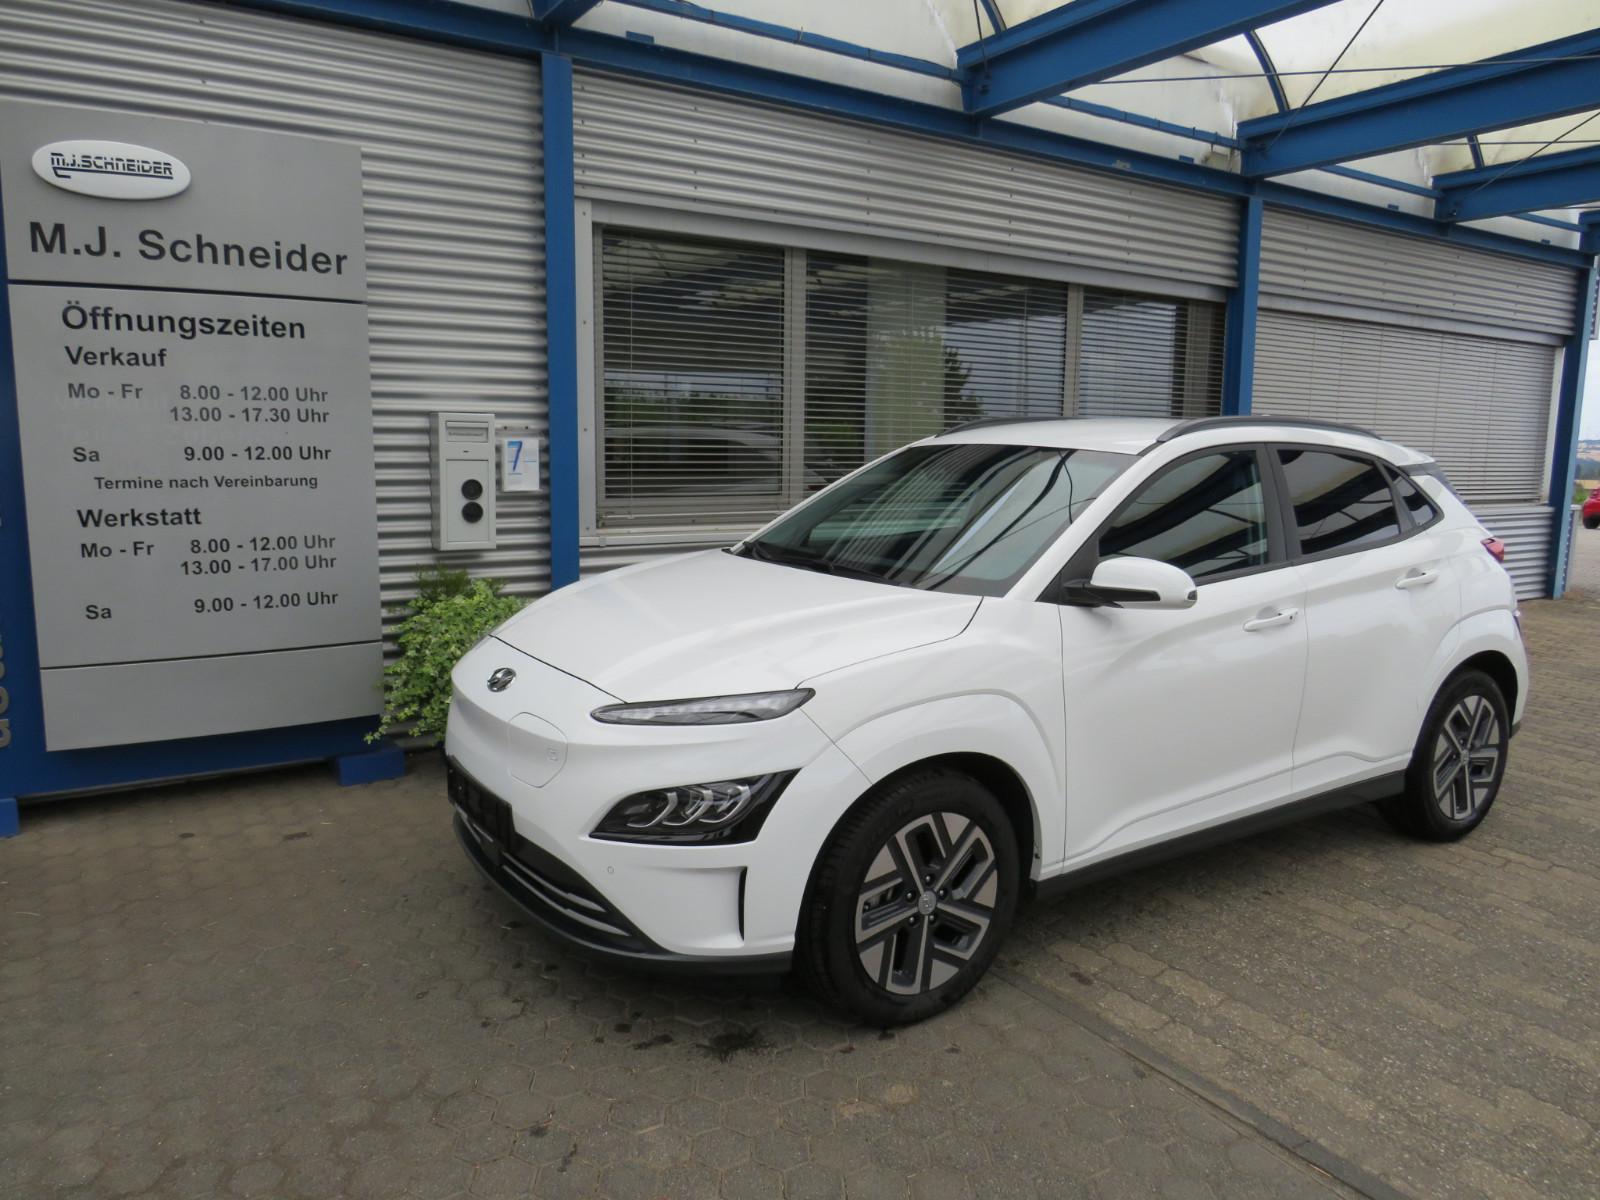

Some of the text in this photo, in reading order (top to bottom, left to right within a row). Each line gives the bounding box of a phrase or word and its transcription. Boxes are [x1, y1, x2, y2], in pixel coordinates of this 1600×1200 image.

[29, 221, 348, 275] M.J. Schneider
[61, 301, 306, 340] Öffnungszeiten
[64, 344, 167, 367] Verkauf
[68, 382, 100, 399] Mo
[121, 384, 143, 399] Fr
[180, 385, 220, 400] 8.00
[240, 386, 289, 402] 12.00
[296, 387, 328, 402] Uhr
[170, 406, 222, 422] 13.00
[241, 407, 291, 423] 17.30
[297, 408, 330, 423] Uhr
[73, 446, 100, 462] Sa
[184, 446, 224, 461] 9.00
[244, 446, 293, 461] 12.00
[299, 445, 332, 460] Uhr
[93, 475, 318, 490] Termine nach Vereinbarung
[76, 508, 202, 528] Werkstatt
[80, 543, 112, 558] Mo
[133, 541, 155, 556] Fr
[190, 538, 230, 554] 8.00
[249, 536, 297, 552] 12.00
[304, 535, 336, 549] Uhr
[180, 559, 231, 575] 13.00
[251, 556, 299, 572] 17.00
[305, 555, 337, 569] Uhr
[85, 604, 112, 620] Sa
[194, 597, 234, 613] 9.00
[253, 593, 301, 609] 12.00
[307, 591, 339, 606] Uhr
